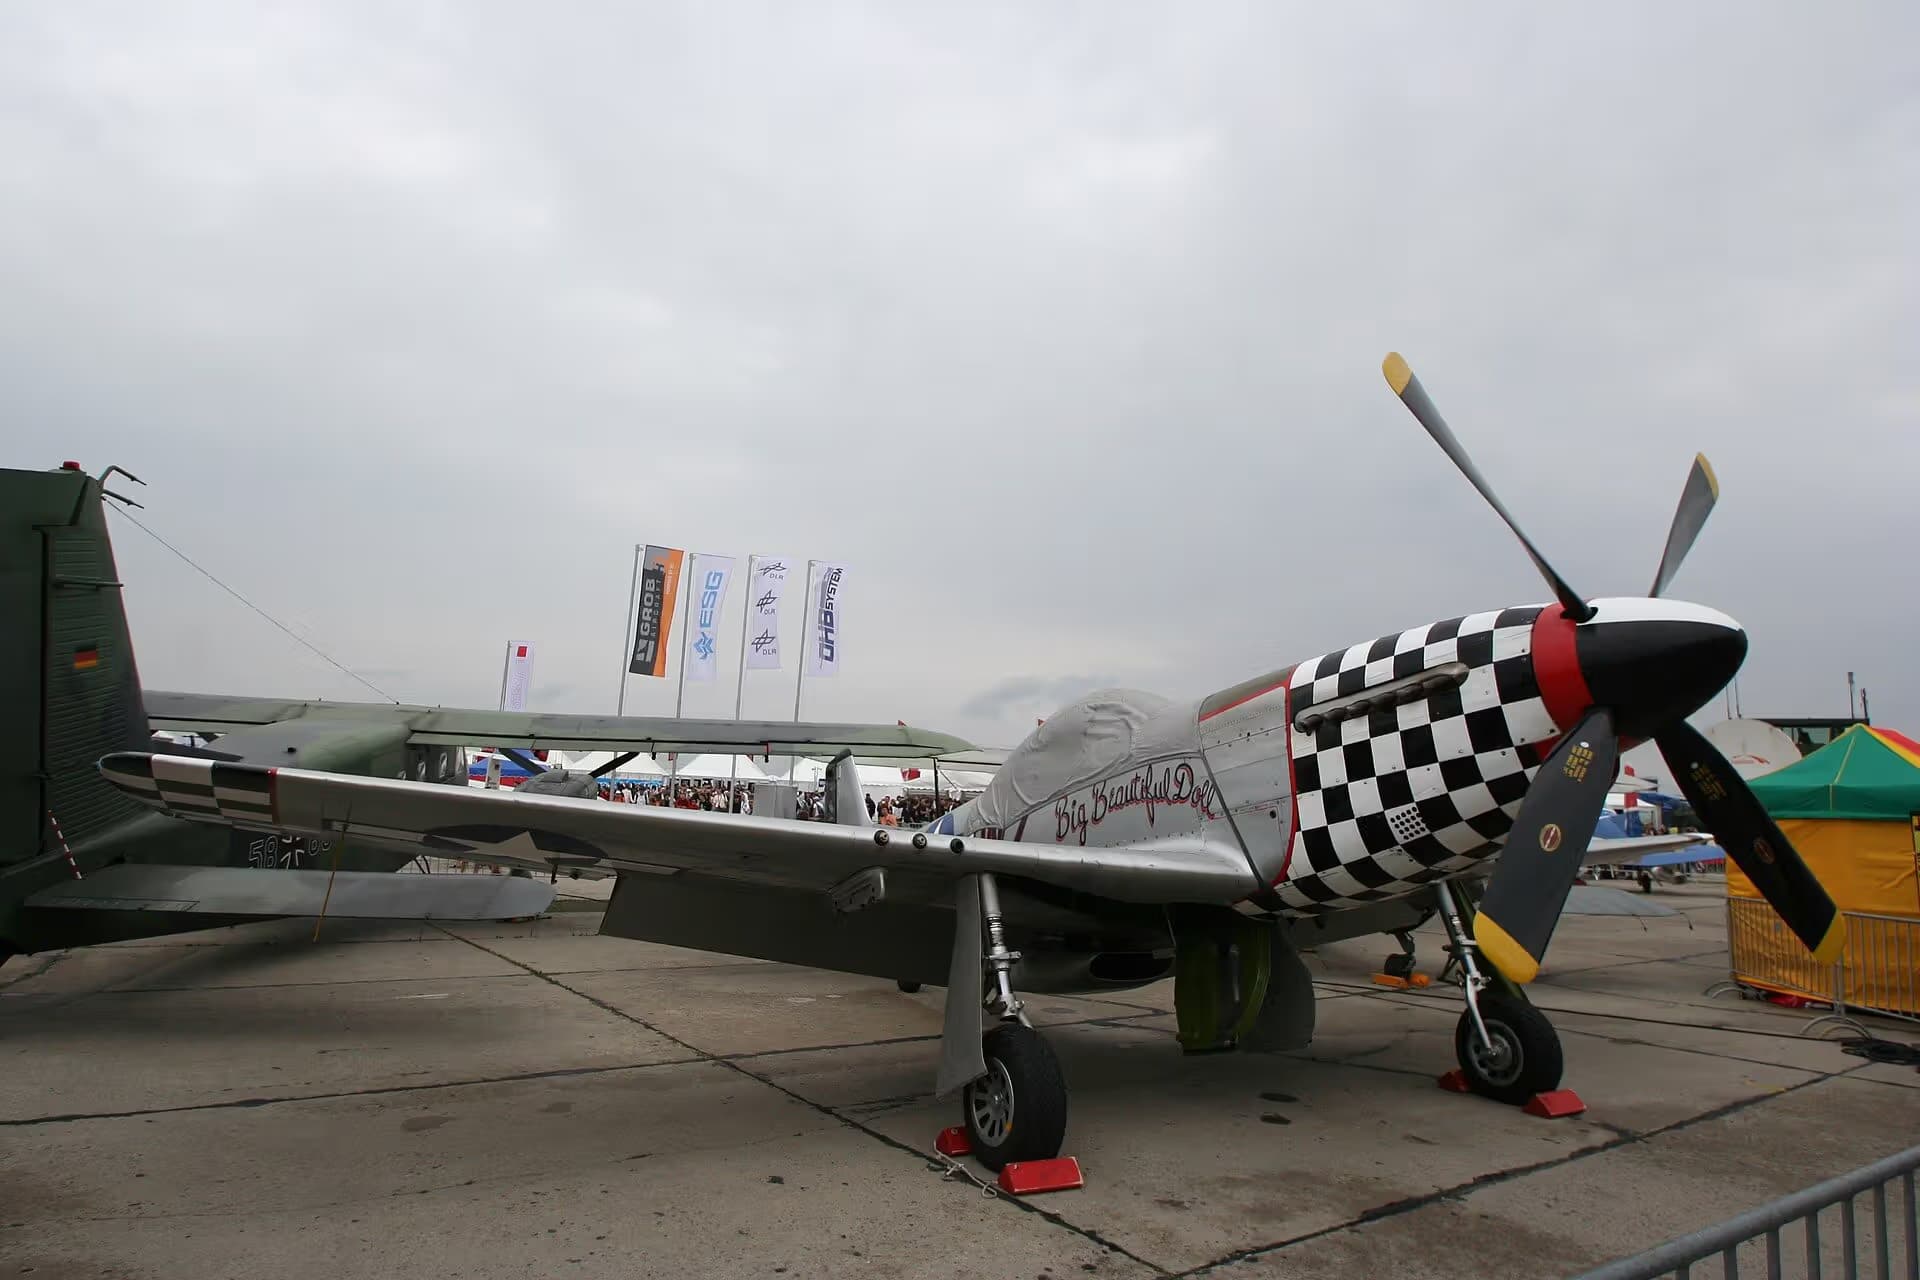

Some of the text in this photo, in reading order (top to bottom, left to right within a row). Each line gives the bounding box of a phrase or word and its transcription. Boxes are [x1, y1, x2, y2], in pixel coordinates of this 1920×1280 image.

[769, 573, 785, 581] DLR
[640, 577, 657, 637] GROB
[700, 570, 724, 629] ESG
[763, 608, 777, 616] DLR
[762, 648, 778, 657] DLR
[822, 610, 835, 663] OHB
[1055, 762, 1216, 847] Big Beautiful Doll
[248, 835, 280, 870] 58
